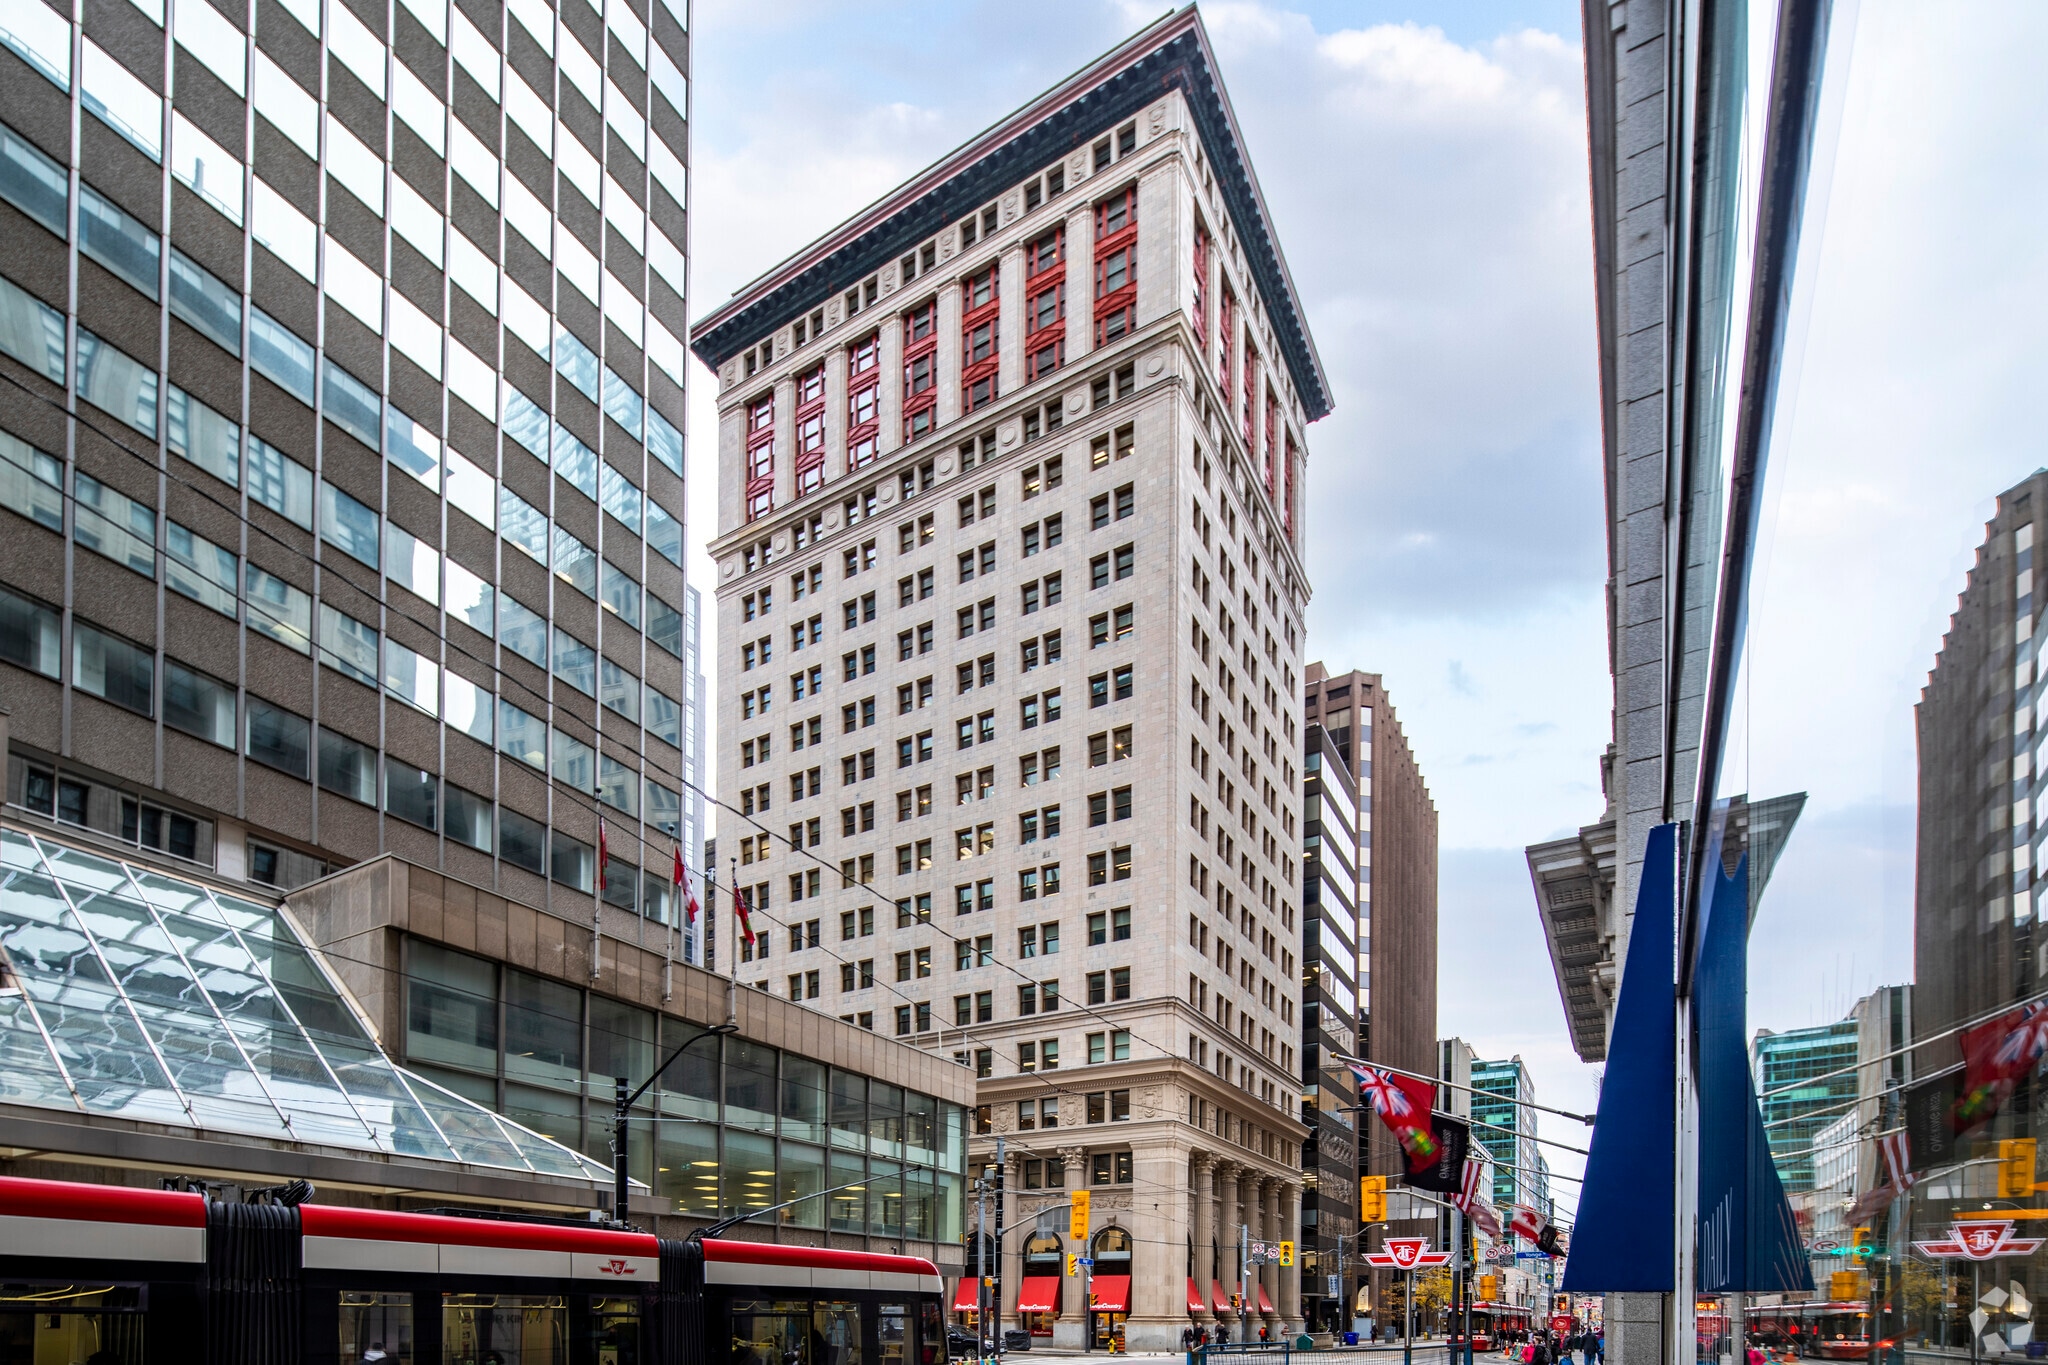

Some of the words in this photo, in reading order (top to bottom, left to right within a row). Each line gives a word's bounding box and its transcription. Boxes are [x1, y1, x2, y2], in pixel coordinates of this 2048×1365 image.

[1703, 1187, 1732, 1292] DAILY
[1394, 1245, 1416, 1262] TTC
[1018, 1303, 1052, 1311] SleepCountry
